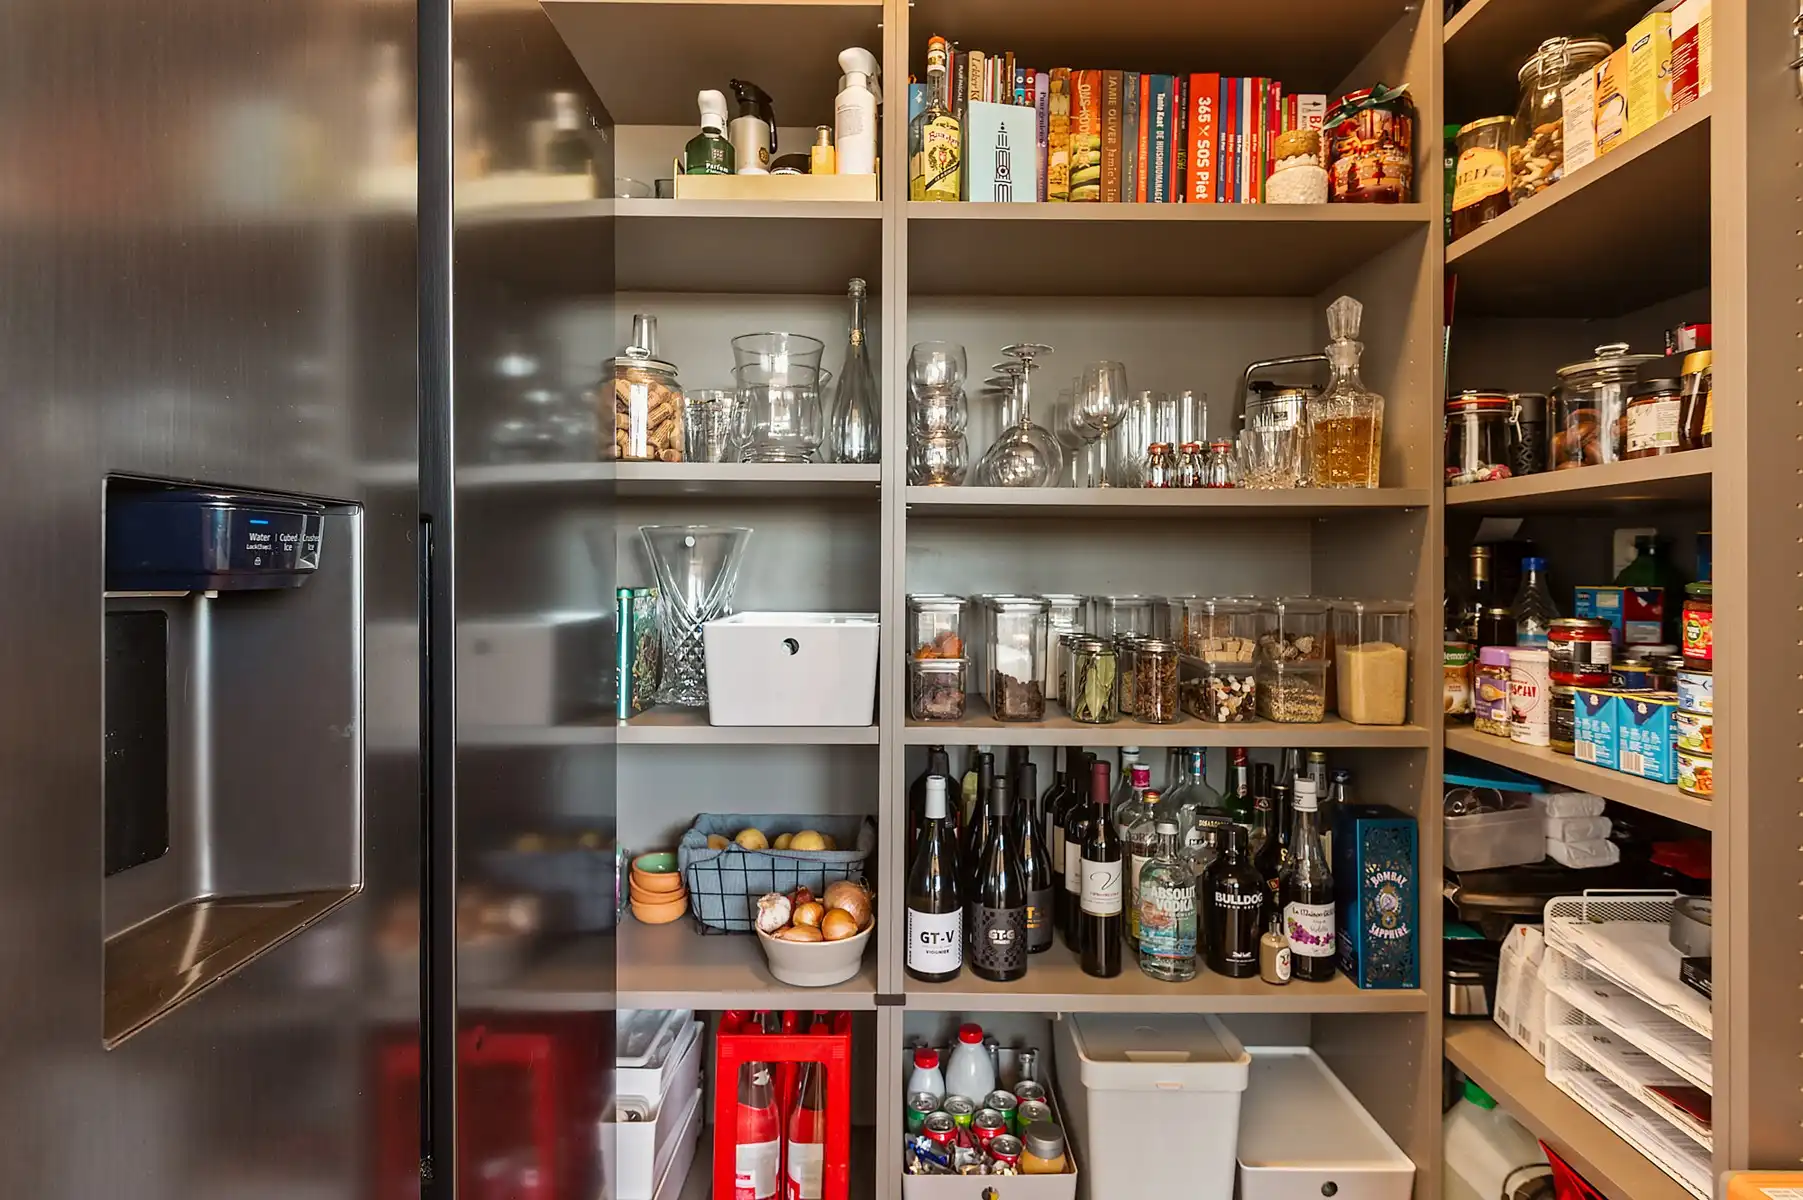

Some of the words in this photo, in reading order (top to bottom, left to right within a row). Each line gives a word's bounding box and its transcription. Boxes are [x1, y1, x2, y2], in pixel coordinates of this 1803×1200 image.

[971, 57, 981, 89] Lekker
[1108, 76, 1117, 105] JAMIE
[1157, 94, 1165, 111] Tante
[1198, 97, 1212, 123] 365
[1107, 108, 1116, 144] OLIVER
[1156, 111, 1165, 128] Kaat
[1156, 130, 1164, 140] DE
[1197, 139, 1211, 168] SOS
[1107, 146, 1117, 185] Jamie's
[1196, 171, 1209, 200] Piet
[249, 532, 271, 542] Water
[279, 533, 298, 542] Cubed
[283, 543, 293, 551] Ice
[307, 543, 315, 551] Ice
[1369, 871, 1408, 889] BOMBAY
[1150, 884, 1196, 900] ABSOLUT
[1215, 890, 1263, 906] BULLDOG
[1155, 898, 1194, 913] VODKA
[920, 930, 955, 945] GT-V
[1367, 922, 1411, 940] SAPPHIRE
